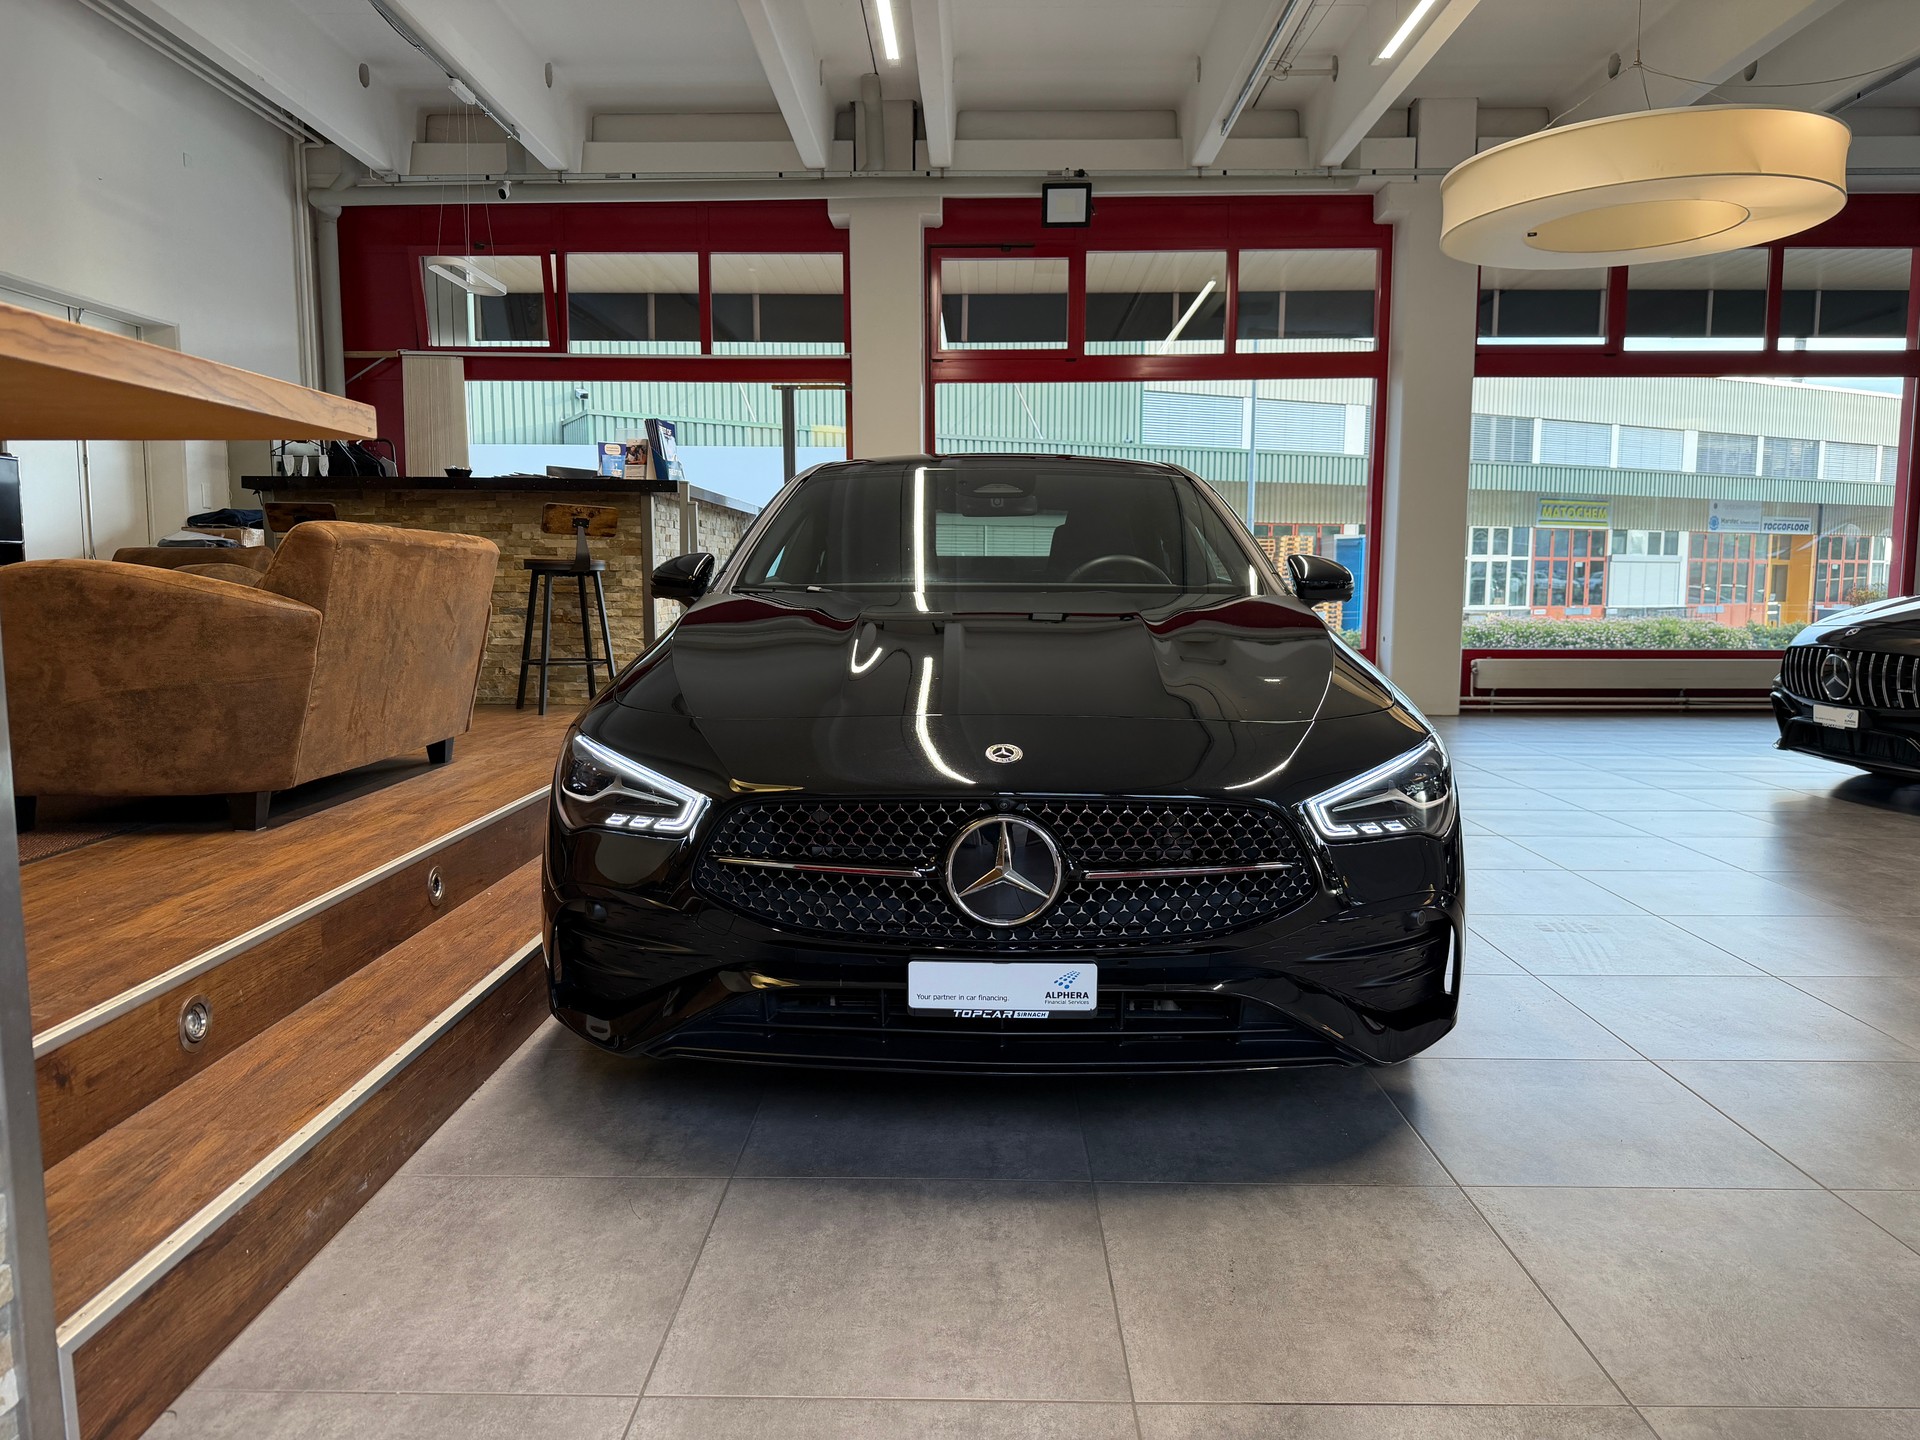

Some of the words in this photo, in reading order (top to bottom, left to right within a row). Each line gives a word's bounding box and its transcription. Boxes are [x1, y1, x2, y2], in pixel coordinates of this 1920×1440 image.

[1541, 505, 1608, 520] MATOCHEM
[978, 994, 1010, 1002] financing.
[953, 1009, 1013, 1018] TOPCAR
